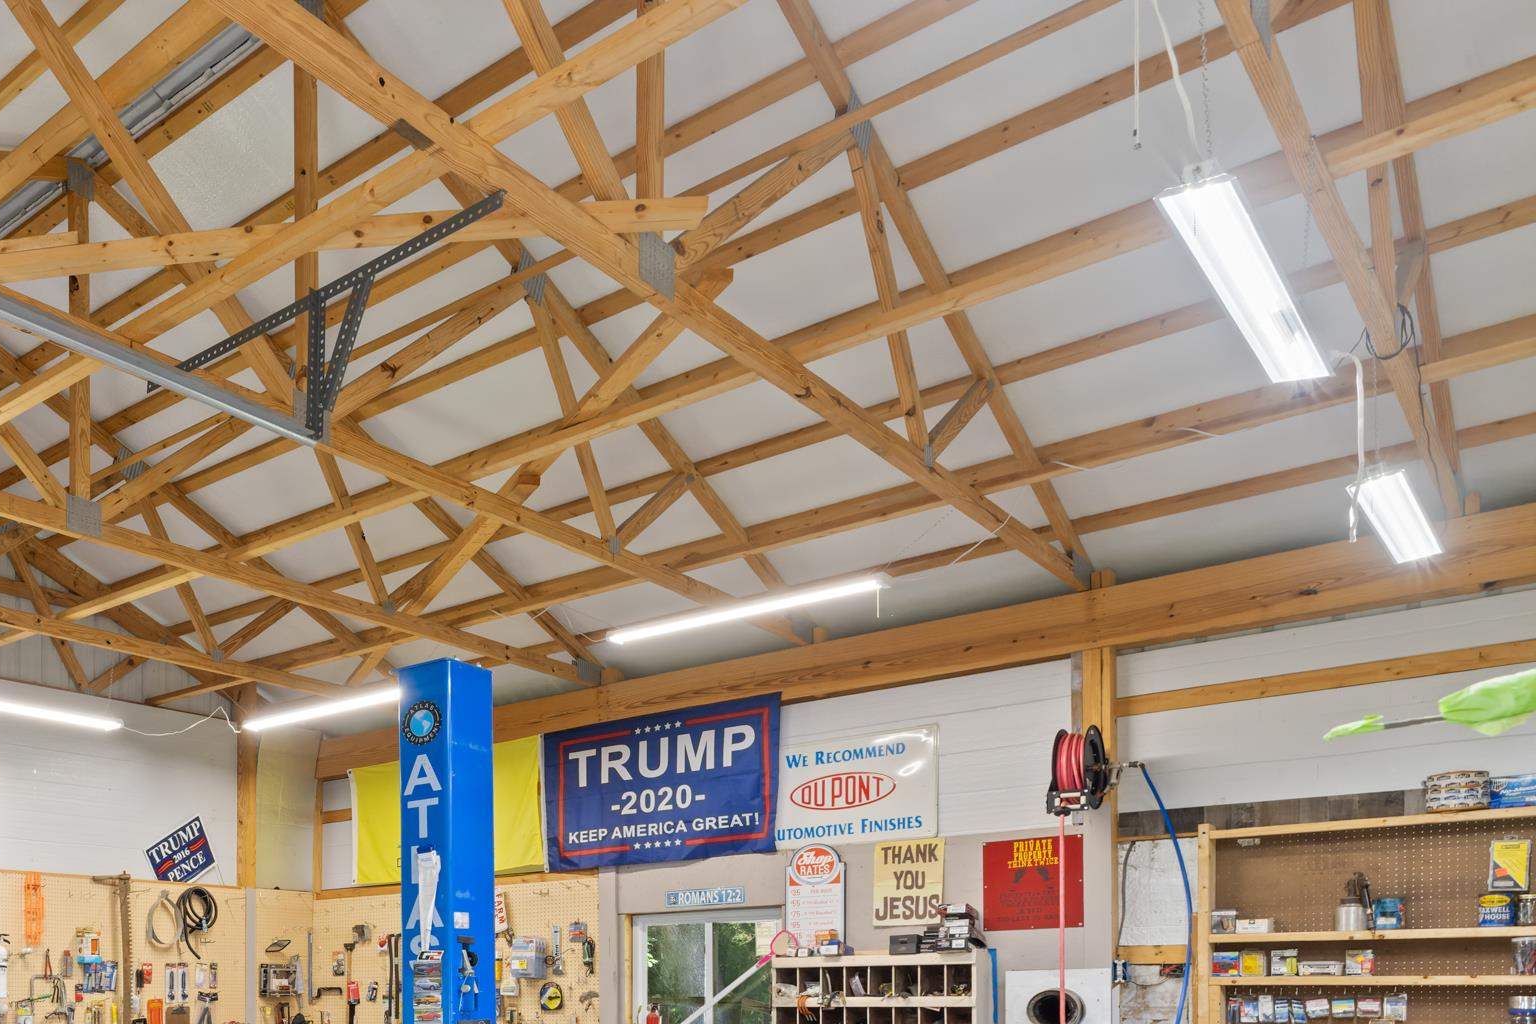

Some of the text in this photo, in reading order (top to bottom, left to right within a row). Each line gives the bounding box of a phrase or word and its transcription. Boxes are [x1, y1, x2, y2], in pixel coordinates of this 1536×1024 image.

[569, 724, 756, 788] TRUMP
[816, 743, 905, 765] RECOMMEND
[568, 812, 759, 844] KEEP AMERICA GREAT!
[777, 816, 923, 841] UTOMOTIVE FINISHES
[148, 820, 200, 864] TRUMP
[1014, 839, 1053, 852] PRIVATE
[173, 847, 191, 864] 2016
[798, 851, 833, 866] Shop
[881, 843, 938, 864] THANK
[1014, 850, 1052, 860] PROPERTY
[168, 851, 206, 882] PENCE
[800, 865, 830, 876] RATES
[894, 870, 925, 890] YOU
[678, 889, 742, 904] ROMANS 12:2
[875, 894, 940, 920] JESUS
[496, 893, 505, 924] FARM
